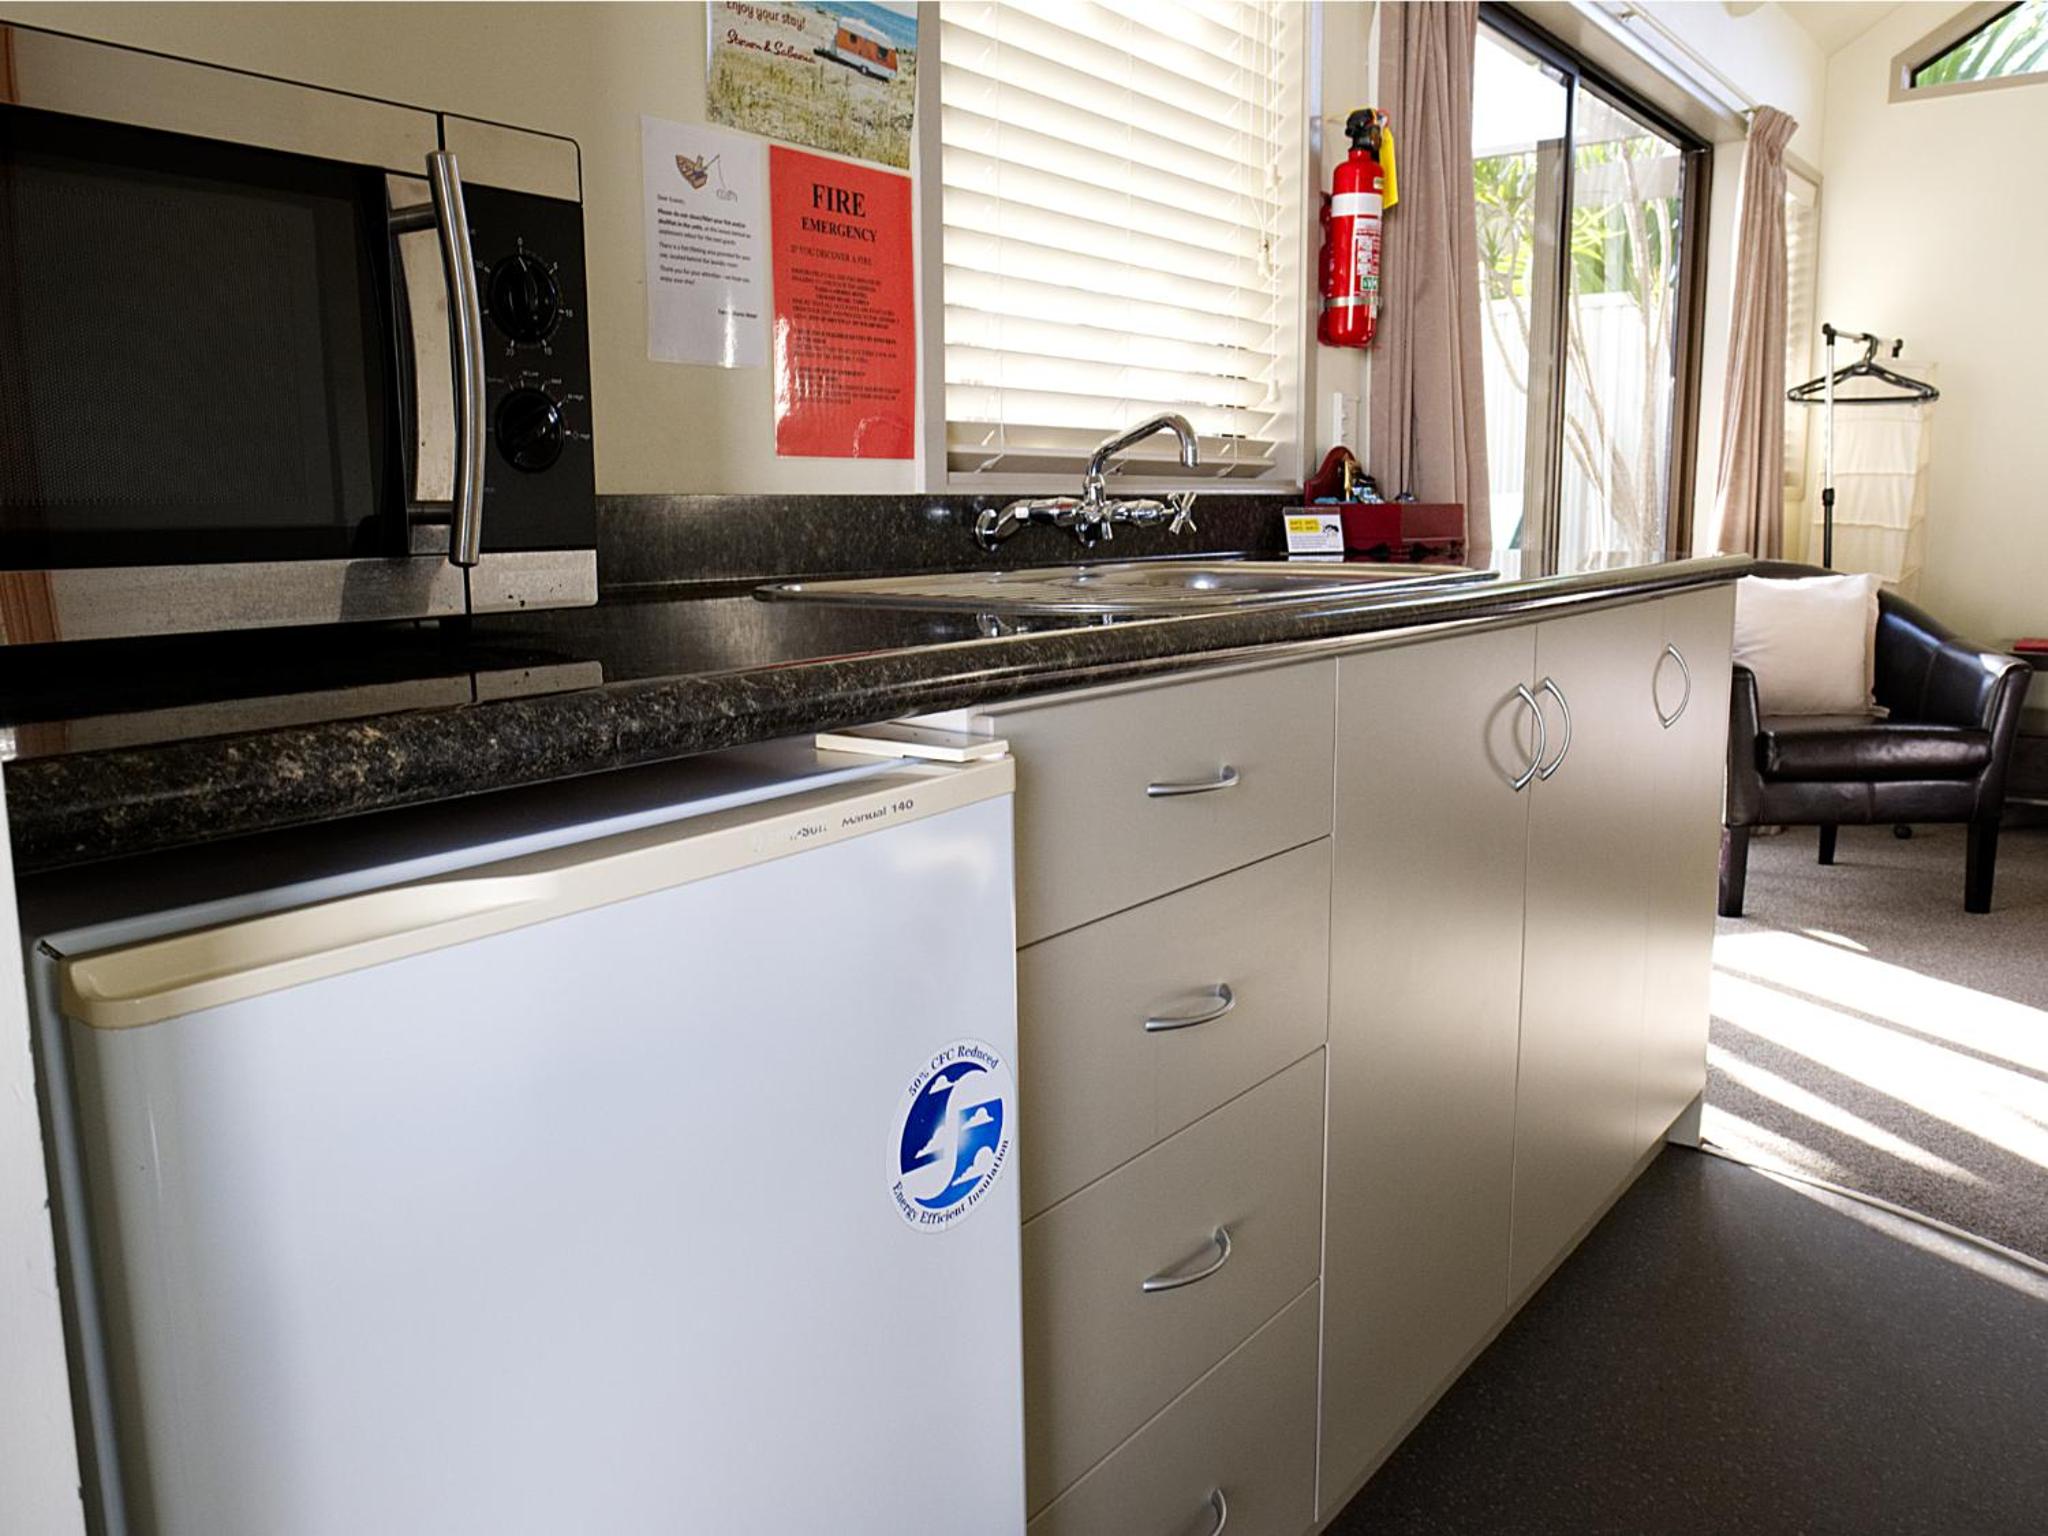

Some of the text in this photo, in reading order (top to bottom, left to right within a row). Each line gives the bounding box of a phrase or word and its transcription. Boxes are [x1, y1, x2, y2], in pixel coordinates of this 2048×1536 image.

[755, 7, 779, 21] your
[812, 183, 866, 218] FIRE
[801, 216, 878, 243] EMERGENCY
[842, 799, 914, 828] Manual 140
[907, 1044, 1000, 1097] 50% CFC Reduced
[892, 1139, 1010, 1225] Energy Efficient Insulation
